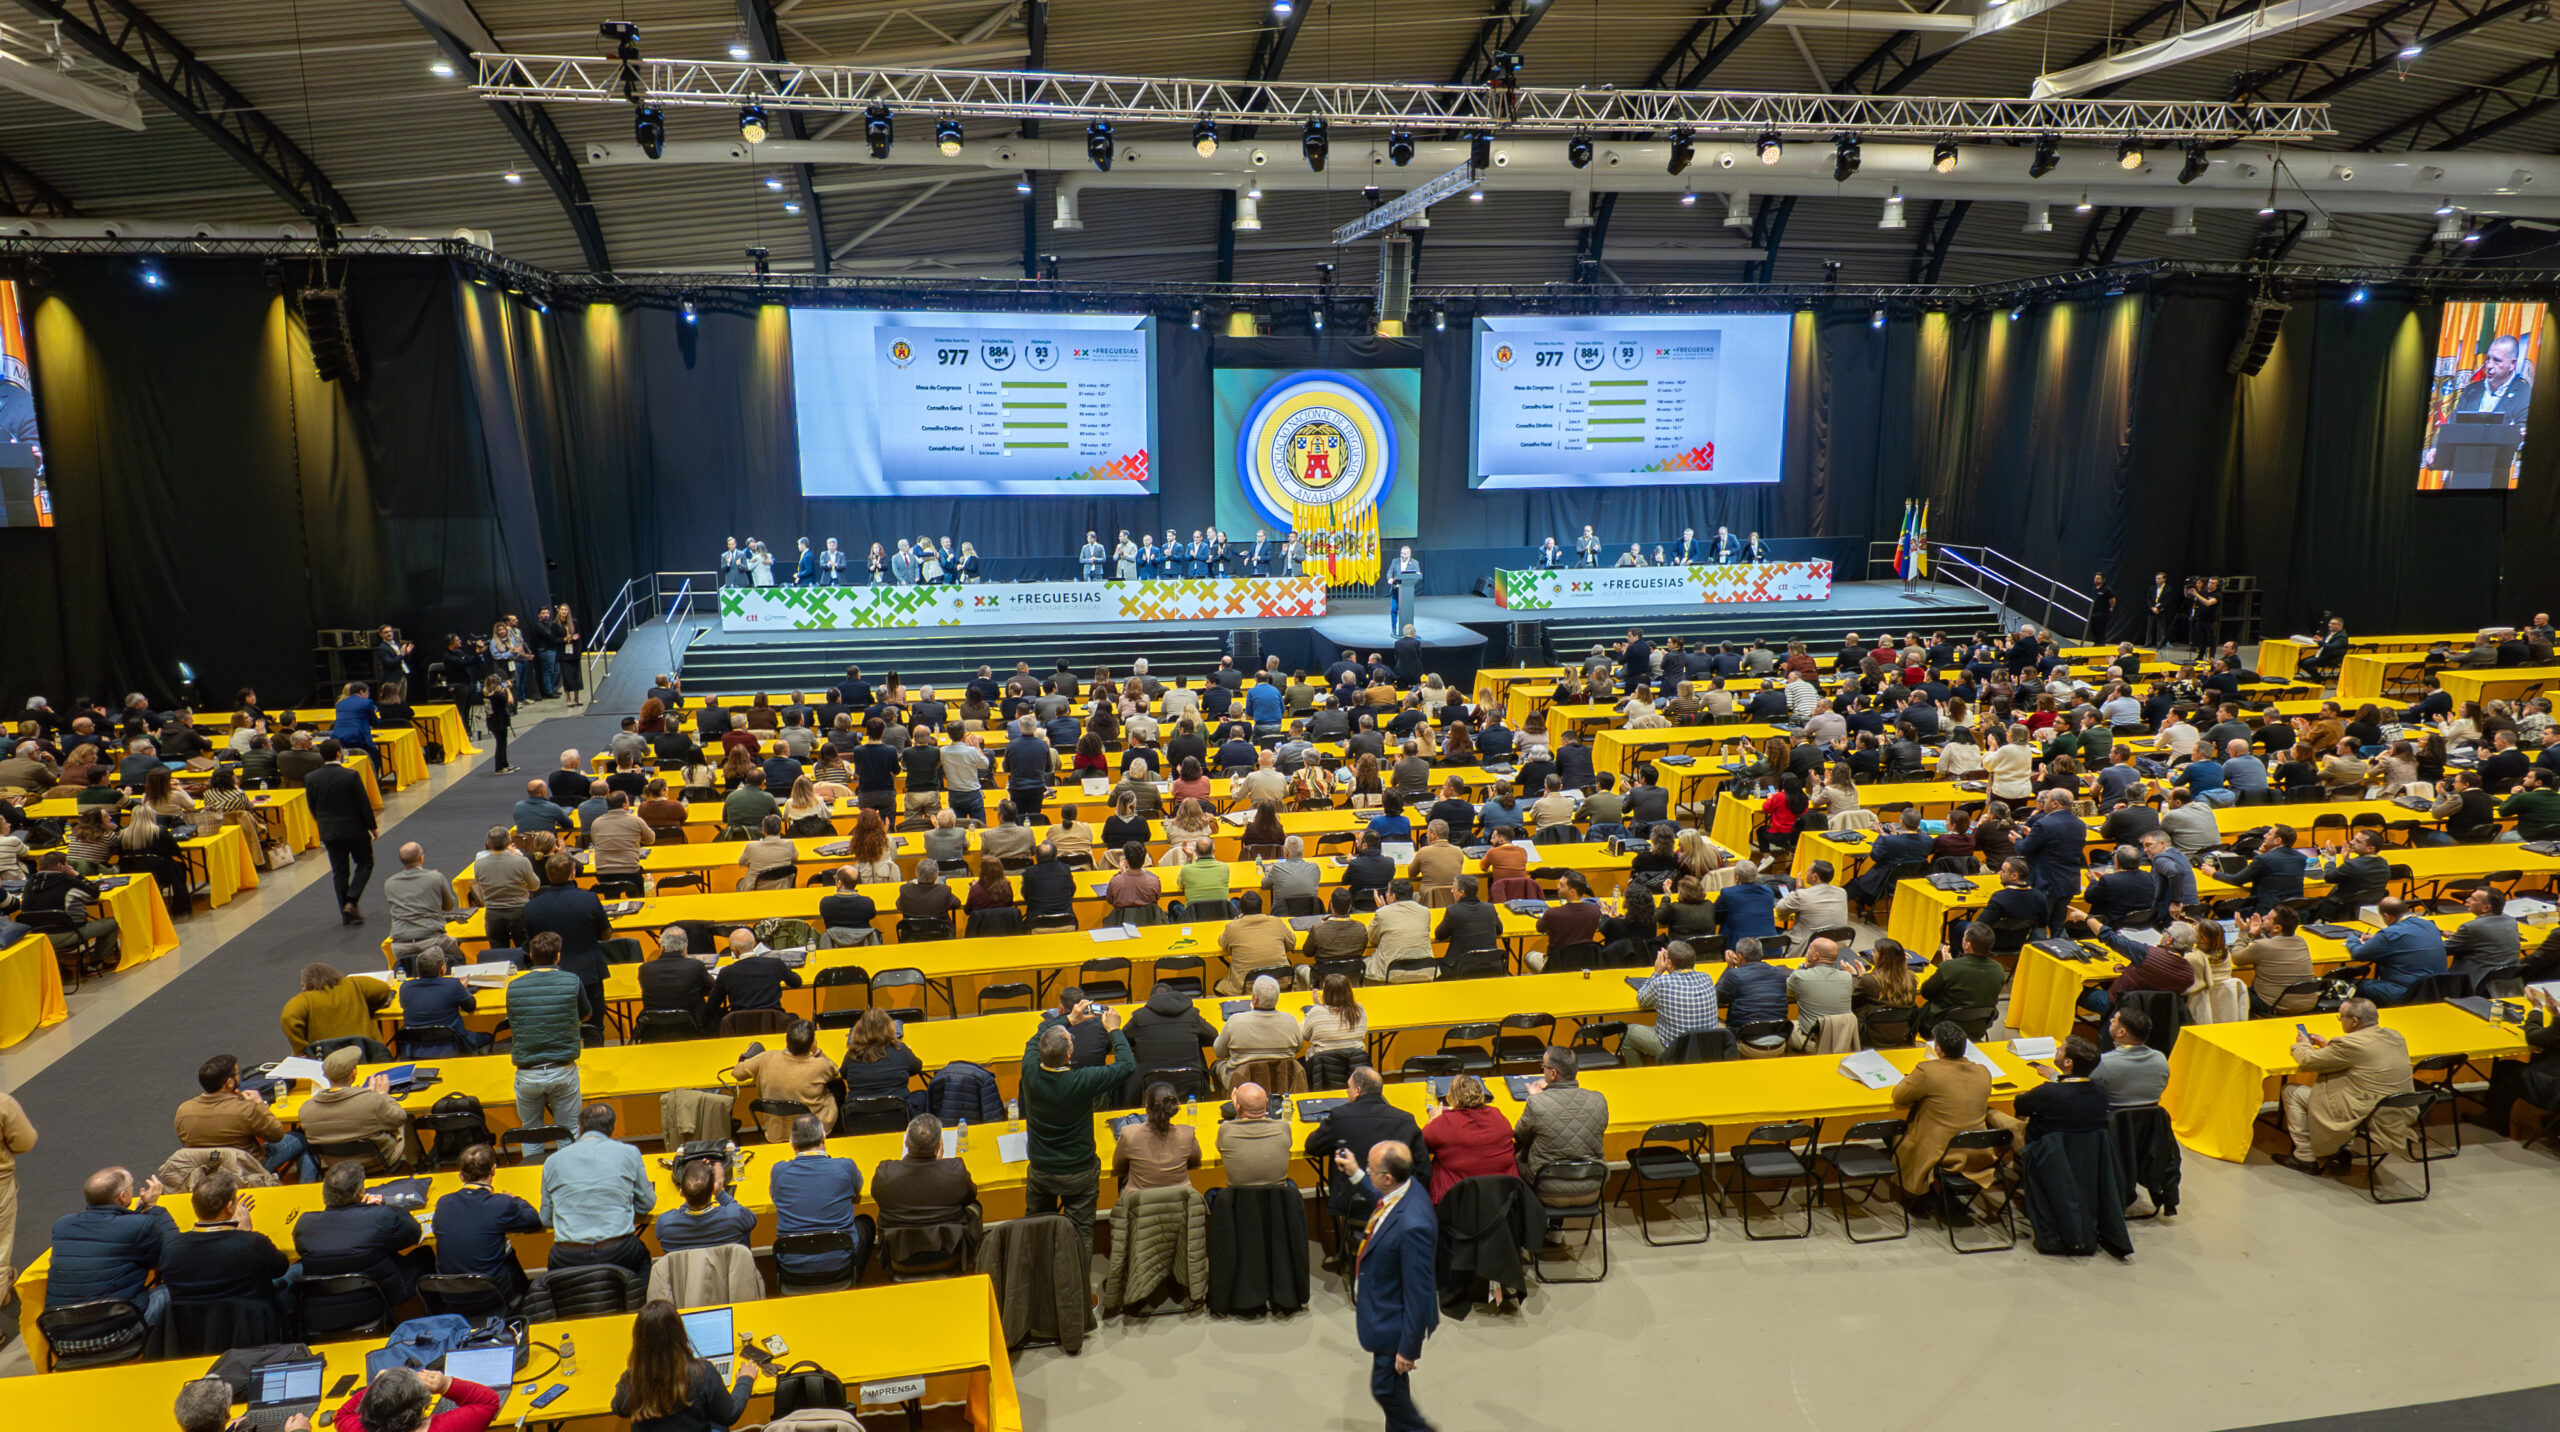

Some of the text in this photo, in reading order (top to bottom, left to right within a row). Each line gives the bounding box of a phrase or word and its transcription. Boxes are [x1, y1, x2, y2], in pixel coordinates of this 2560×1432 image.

[937, 348, 968, 365] 977
[989, 346, 1009, 357] 884
[1035, 347, 1048, 358] 93
[1581, 348, 1599, 358] 884
[1622, 348, 1634, 358] 93
[1536, 352, 1564, 366] 977
[1288, 410, 1331, 426] NACIONAL
[1332, 414, 1346, 427] DE
[1344, 426, 1360, 478] FREGUESIAS
[1295, 488, 1340, 500] ANAFRE
[1602, 578, 1683, 589] +FREGUESIAS
[1010, 592, 1101, 604] +FREGUESIAS
[746, 614, 758, 622] ctt
[868, 1384, 917, 1398] IMPRENSA
